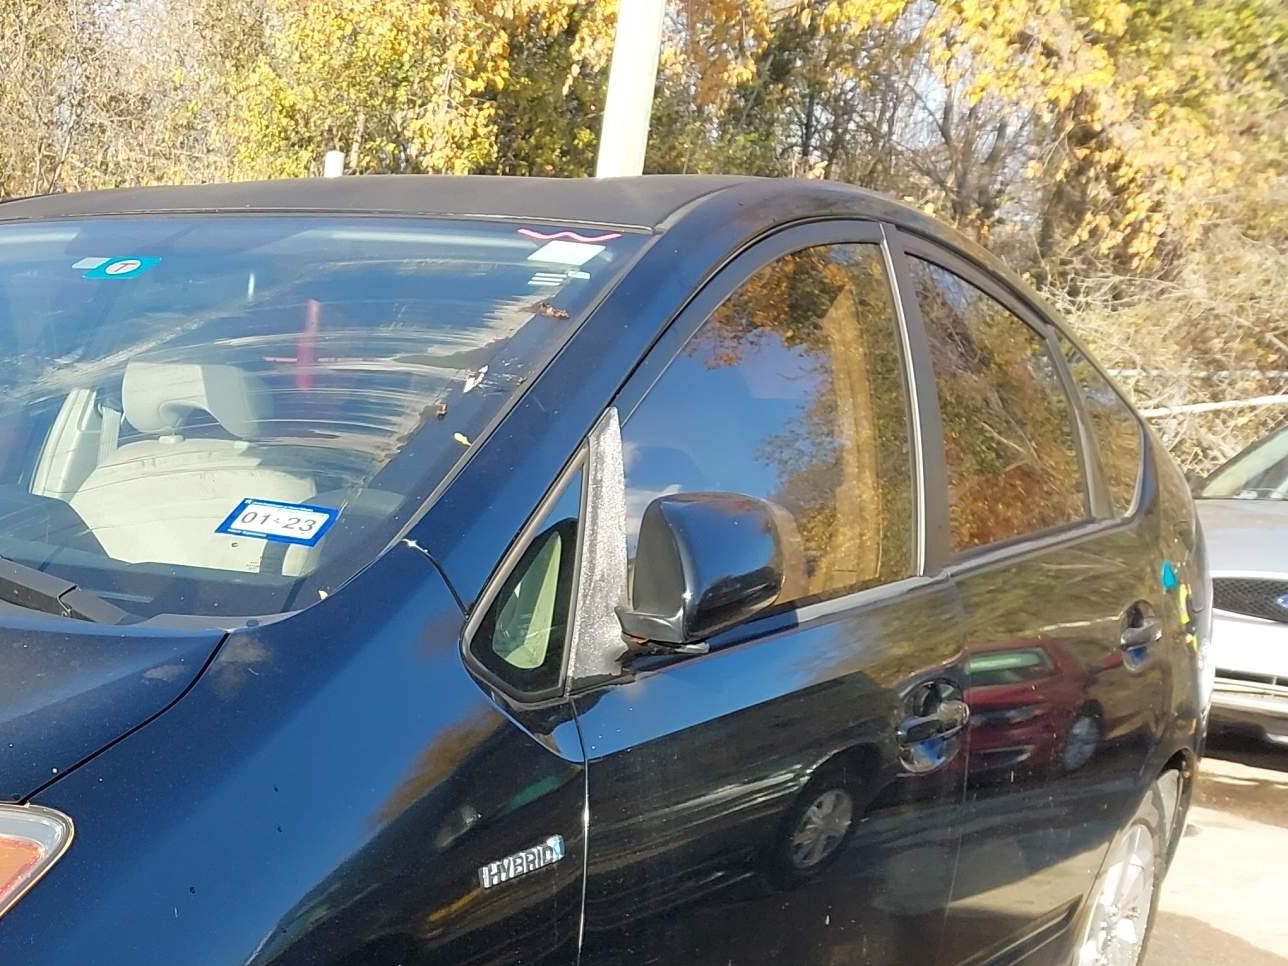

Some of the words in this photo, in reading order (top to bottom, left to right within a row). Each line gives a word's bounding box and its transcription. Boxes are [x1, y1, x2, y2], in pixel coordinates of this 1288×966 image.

[241, 511, 271, 525] 01
[282, 517, 317, 532] 23
[478, 839, 561, 888] HYBRID
